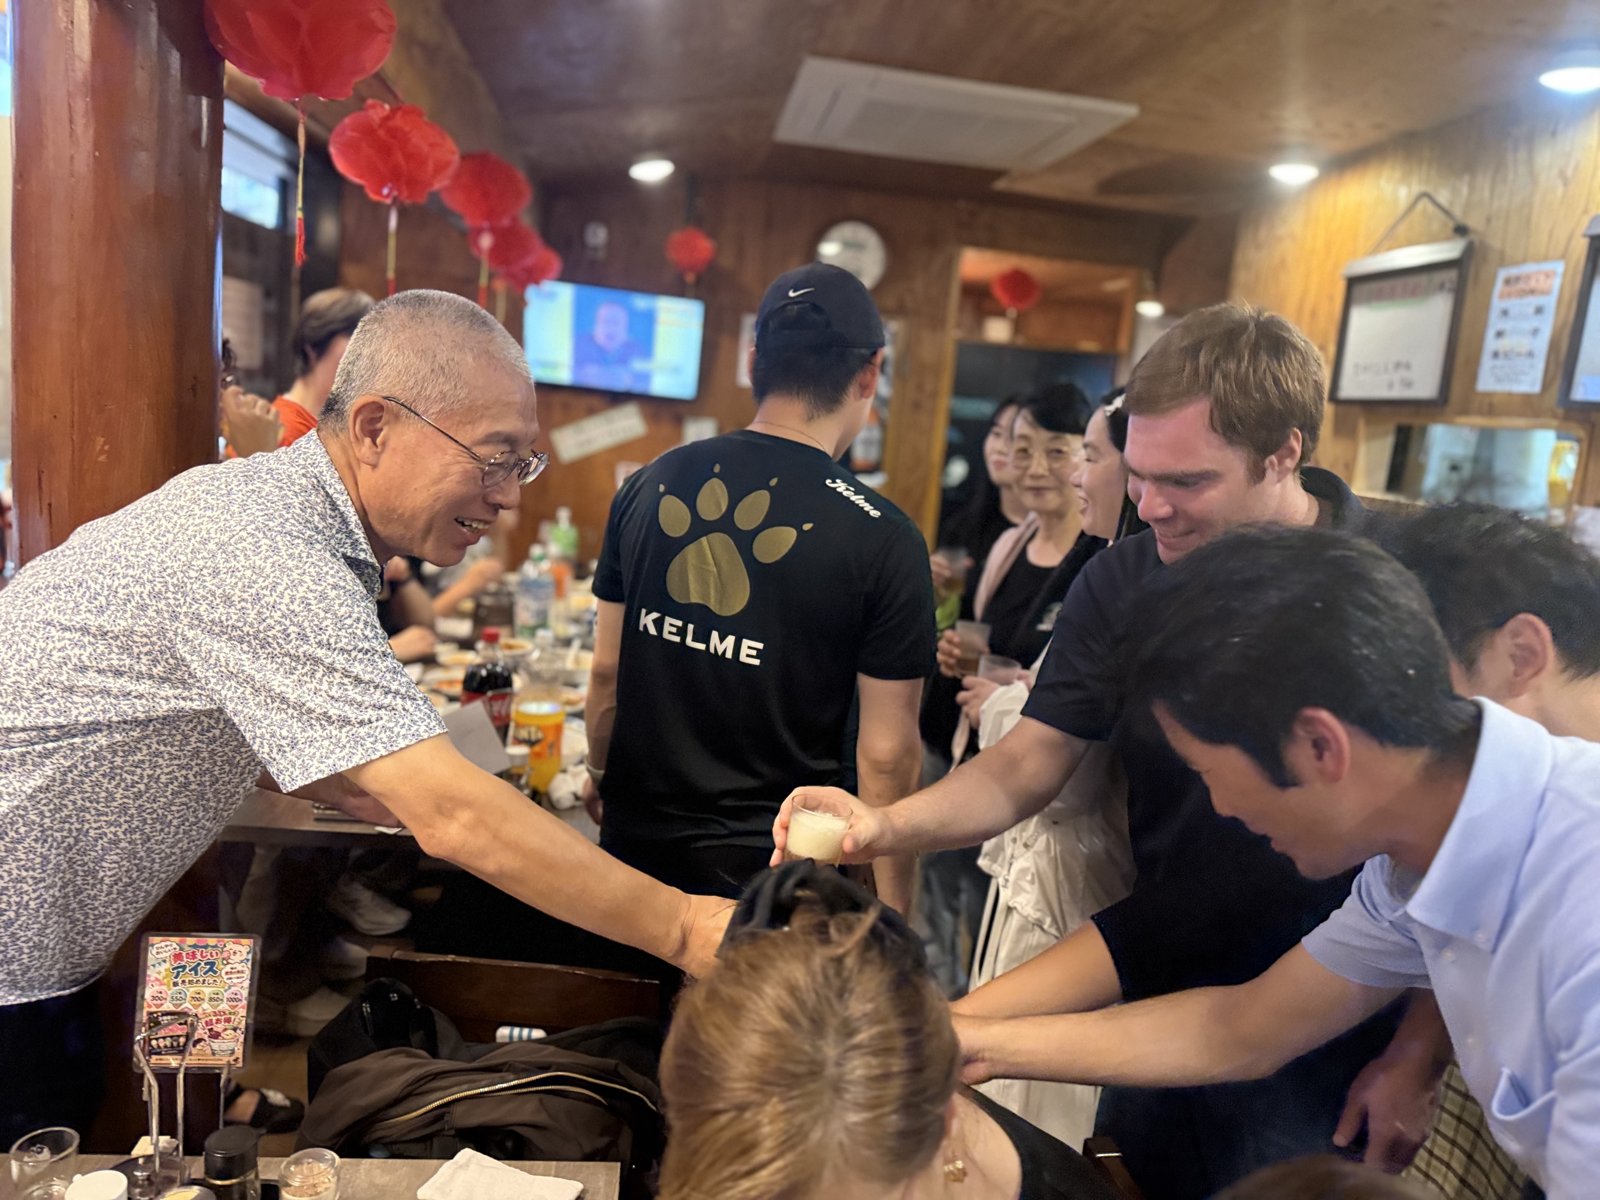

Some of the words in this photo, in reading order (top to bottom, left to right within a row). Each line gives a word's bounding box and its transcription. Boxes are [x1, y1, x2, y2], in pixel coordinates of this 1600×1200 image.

[824, 478, 882, 518] Kelme
[638, 607, 764, 666] KELME
[171, 960, 219, 979] アイス
[172, 949, 220, 964] 美味しい
